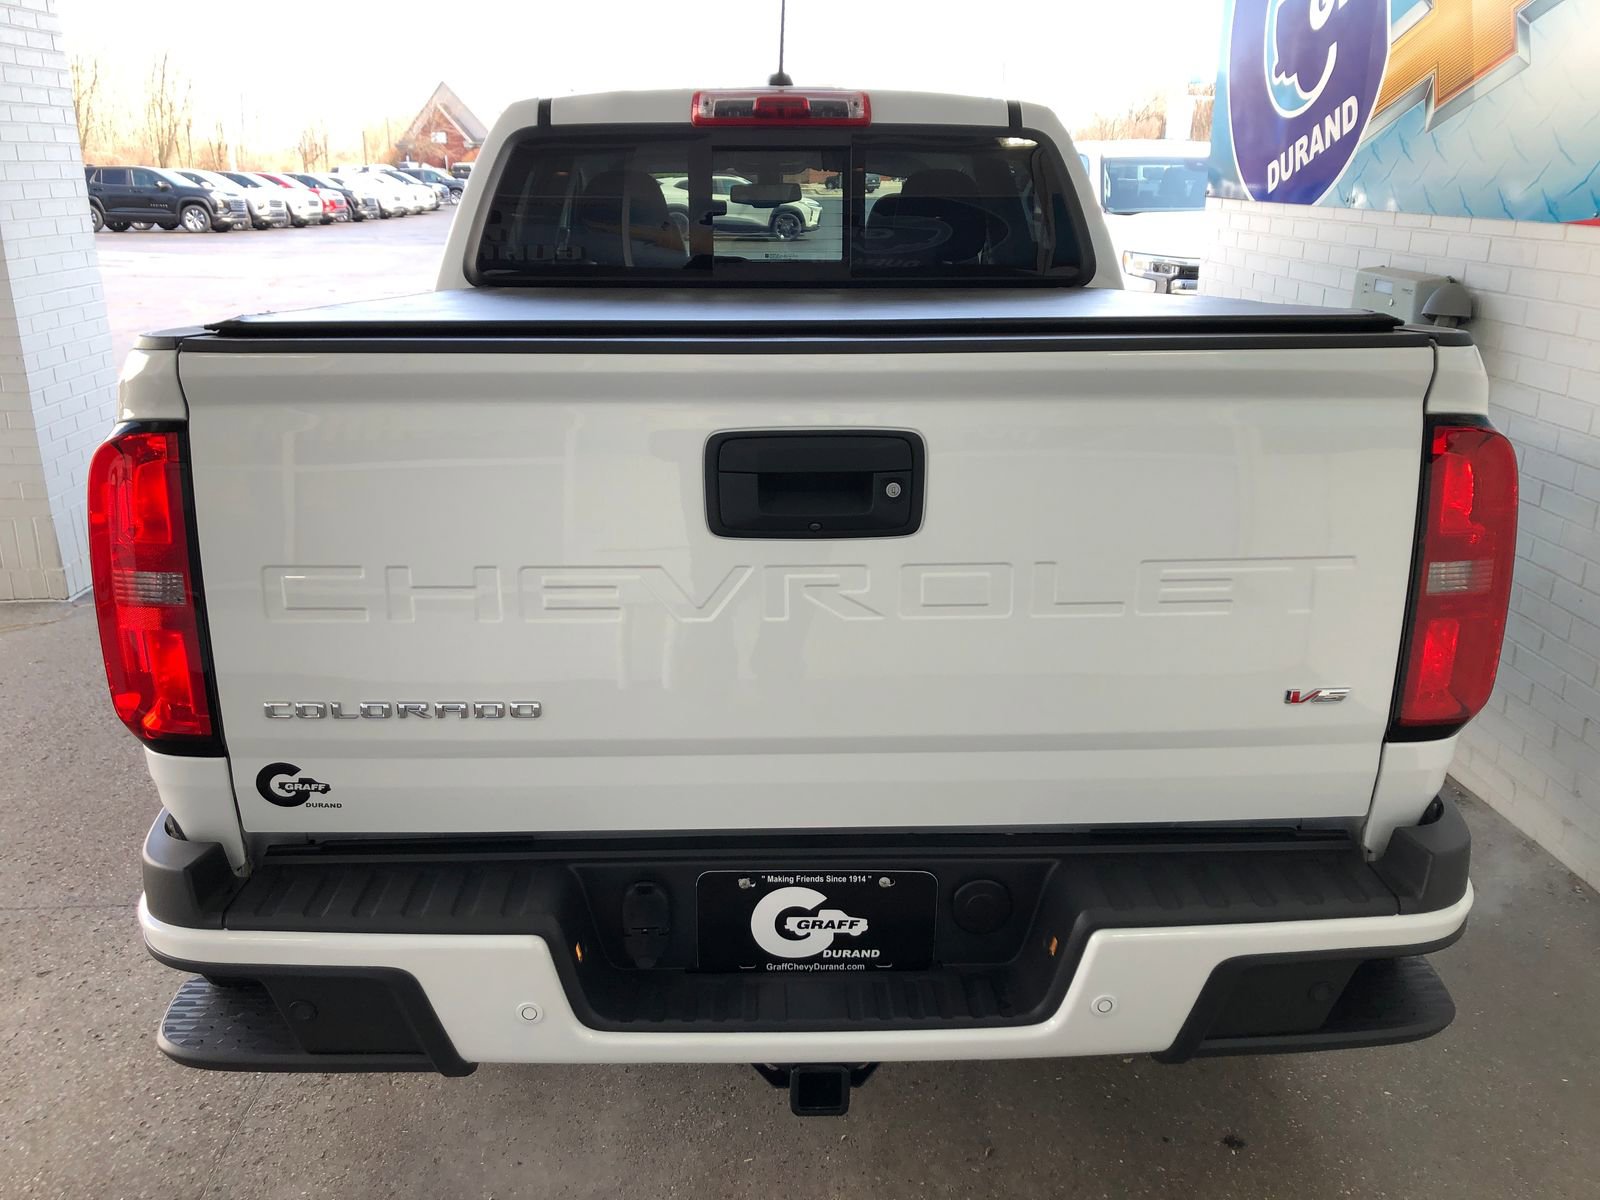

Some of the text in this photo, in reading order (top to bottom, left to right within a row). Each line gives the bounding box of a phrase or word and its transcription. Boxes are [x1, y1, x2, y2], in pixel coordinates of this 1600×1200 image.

[1267, 95, 1359, 194] DURAND
[261, 556, 1356, 624] CHEVROLET
[1284, 687, 1352, 704] V6
[263, 701, 543, 719] COLORADO
[284, 783, 326, 791] GRAFF
[796, 875, 824, 883] Friends
[826, 875, 847, 883] Since
[796, 919, 861, 930] GRAFF
[822, 949, 880, 958] DURAND
[766, 963, 865, 971] GraffChevyDurand.com
